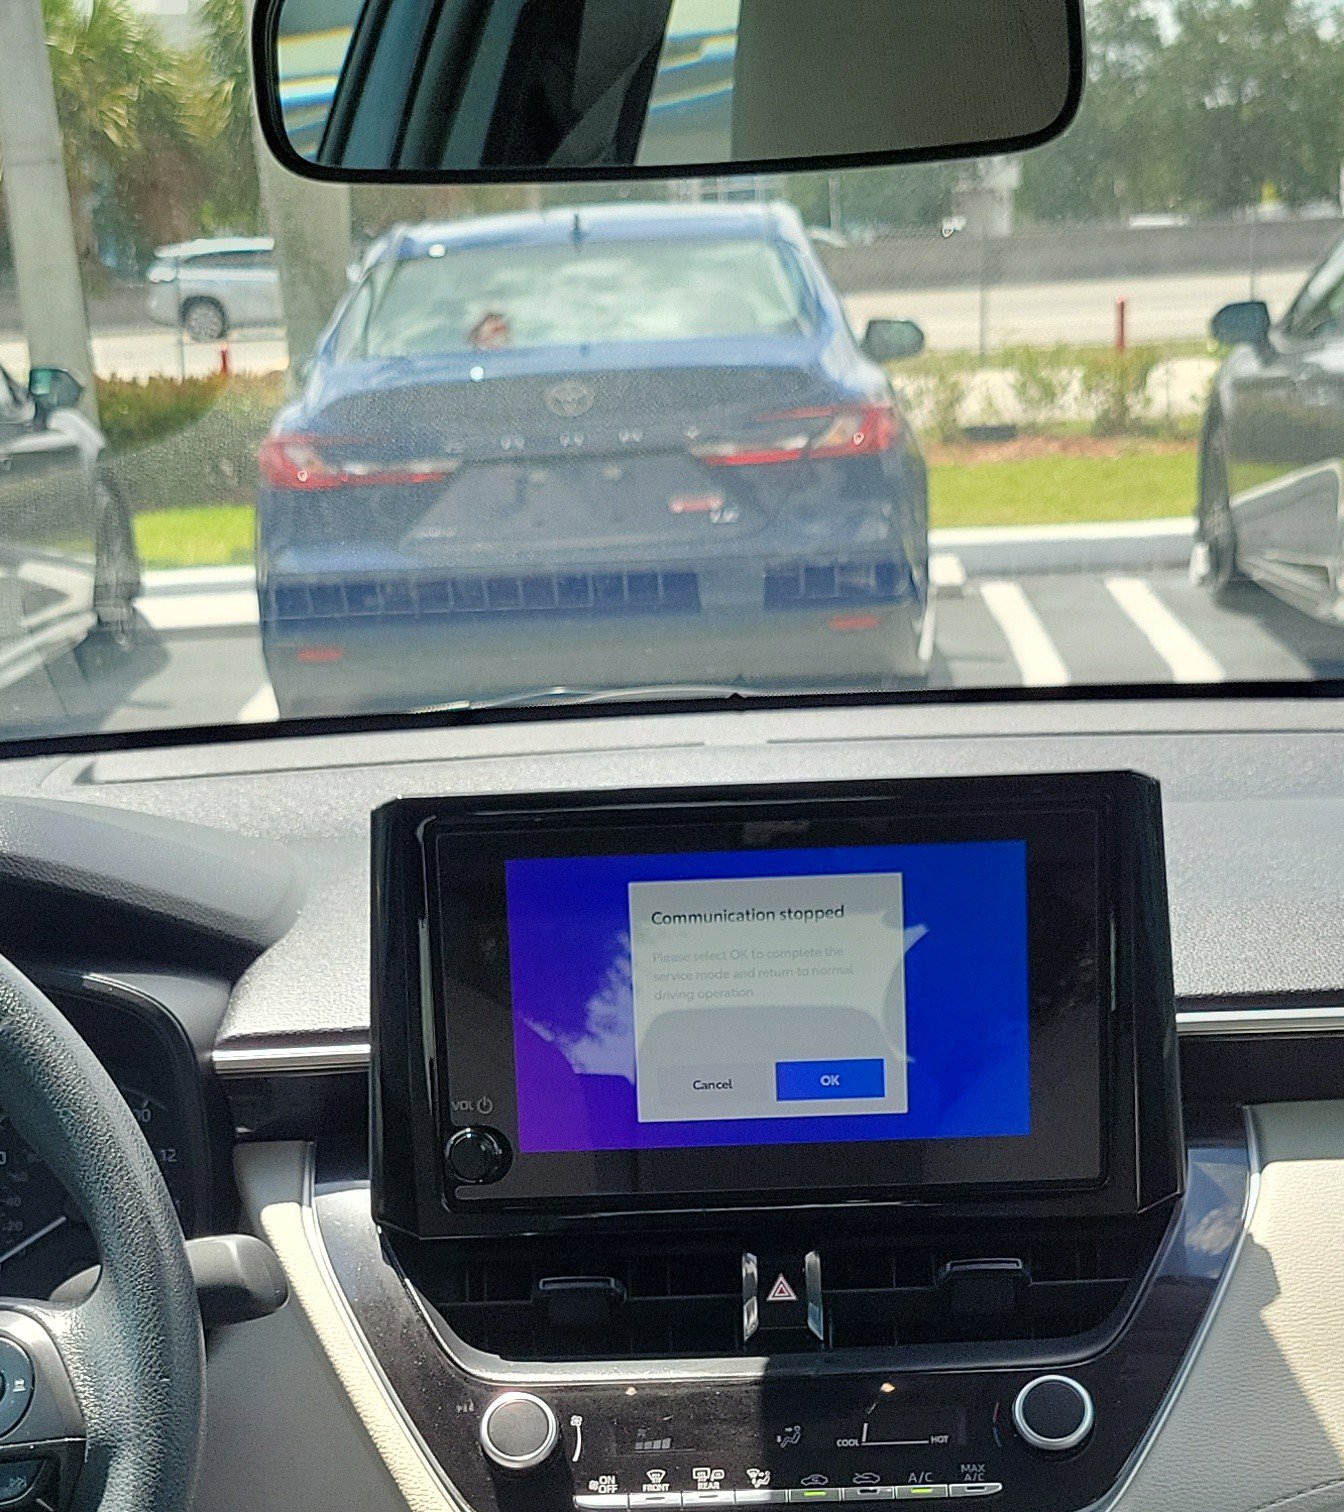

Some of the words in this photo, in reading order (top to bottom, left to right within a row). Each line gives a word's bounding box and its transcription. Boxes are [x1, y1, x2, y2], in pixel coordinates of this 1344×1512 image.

[651, 906, 776, 926] Communication
[779, 904, 845, 923] stopped
[652, 952, 690, 964] Please
[693, 950, 726, 962] select
[729, 949, 749, 961] OK
[752, 949, 764, 961] to
[766, 946, 822, 962] complete
[825, 945, 844, 957] the
[653, 971, 693, 982] service
[696, 968, 730, 980] mode
[733, 967, 756, 979] and
[758, 966, 794, 978] return
[796, 965, 810, 977] to
[812, 963, 854, 976] normal
[654, 989, 694, 1002] driving
[692, 1078, 733, 1091] Cancel
[820, 1074, 840, 1087] OK
[451, 1100, 475, 1111] VOL
[836, 1438, 860, 1448] COOL
[930, 1434, 949, 1444] HOT
[960, 1463, 986, 1473] MAX
[598, 1475, 616, 1484] ON
[907, 1471, 934, 1484] A/C
[963, 1472, 986, 1482] A/C
[597, 1484, 618, 1494] OFF
[642, 1483, 670, 1492] FRONT
[697, 1482, 721, 1490] REAR
